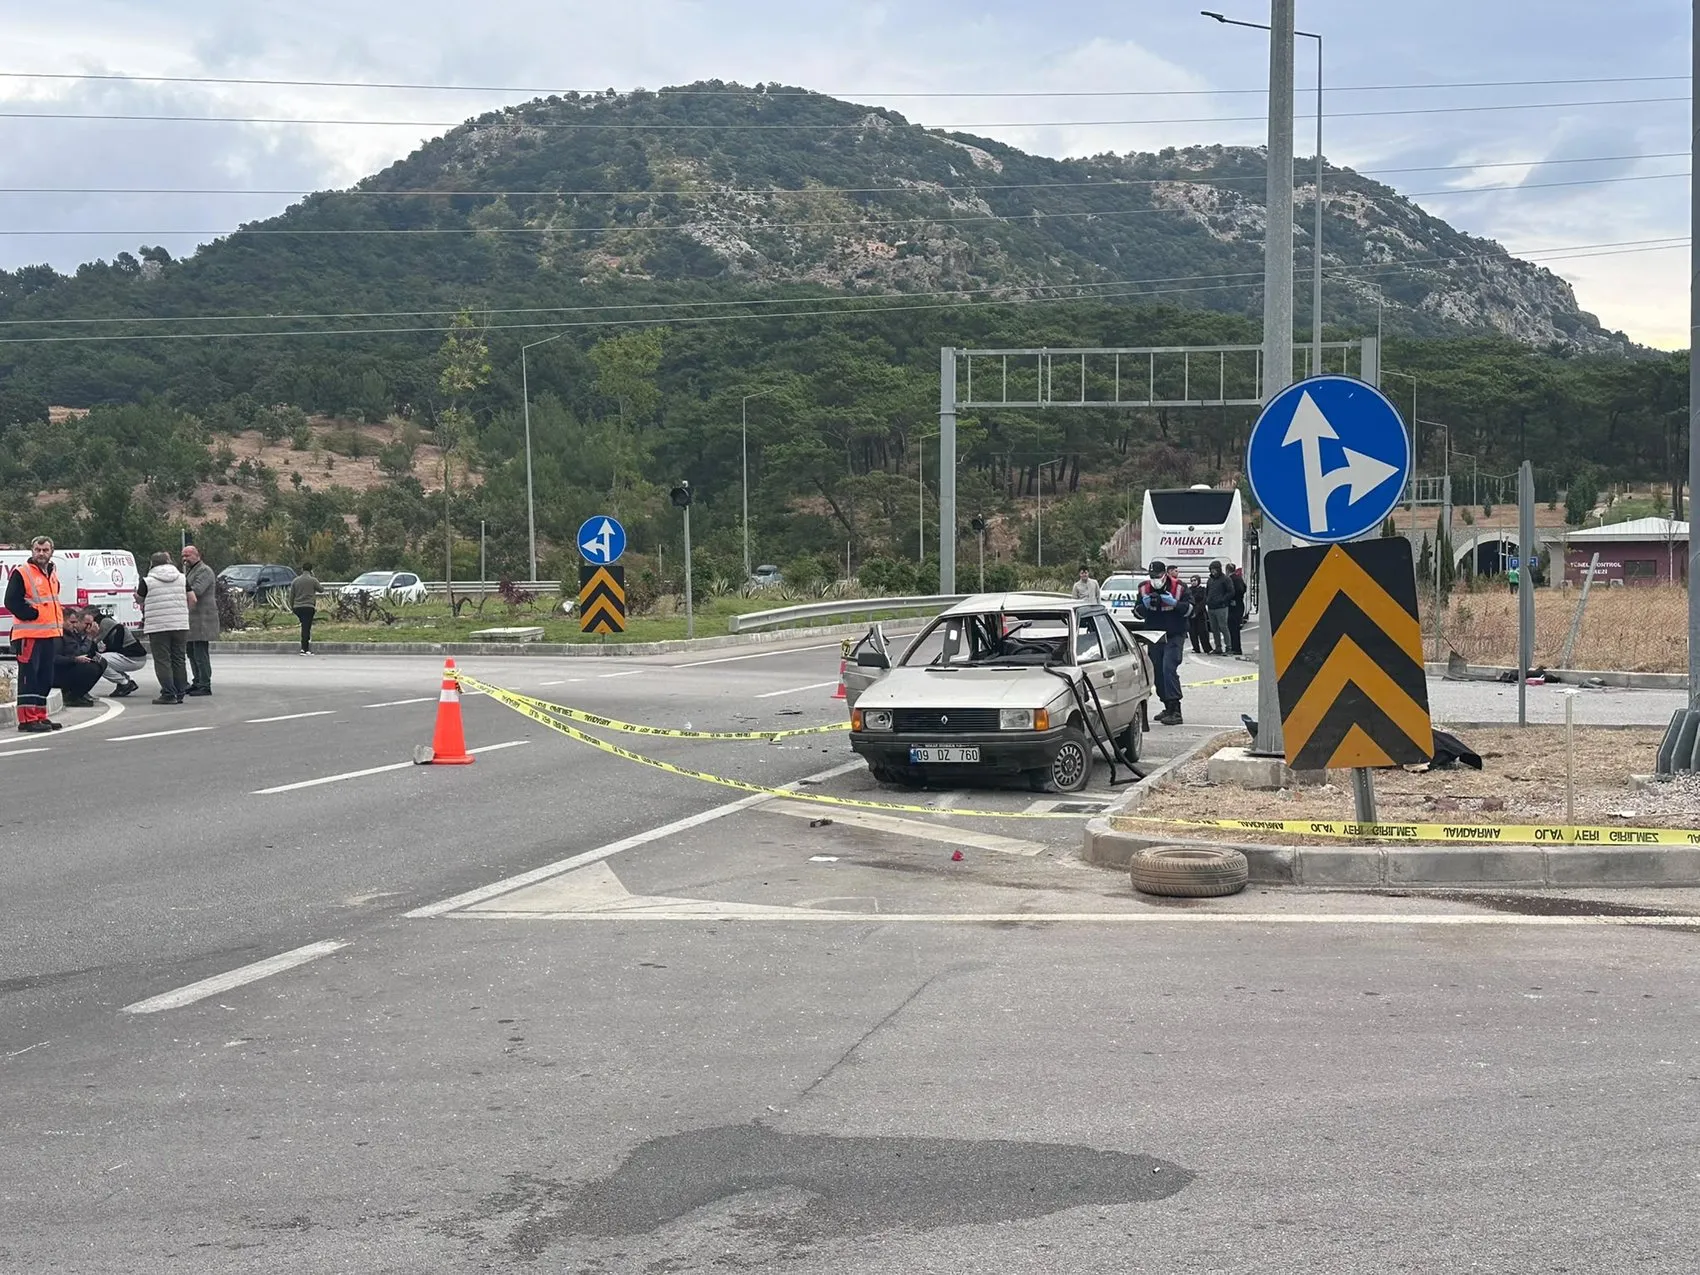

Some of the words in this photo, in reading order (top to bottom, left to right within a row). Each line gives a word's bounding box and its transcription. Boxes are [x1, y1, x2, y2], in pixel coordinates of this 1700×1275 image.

[1160, 537, 1223, 545] PAMUKKALE
[916, 749, 929, 761] 09
[937, 749, 950, 761] DZ
[959, 749, 978, 761] 760
